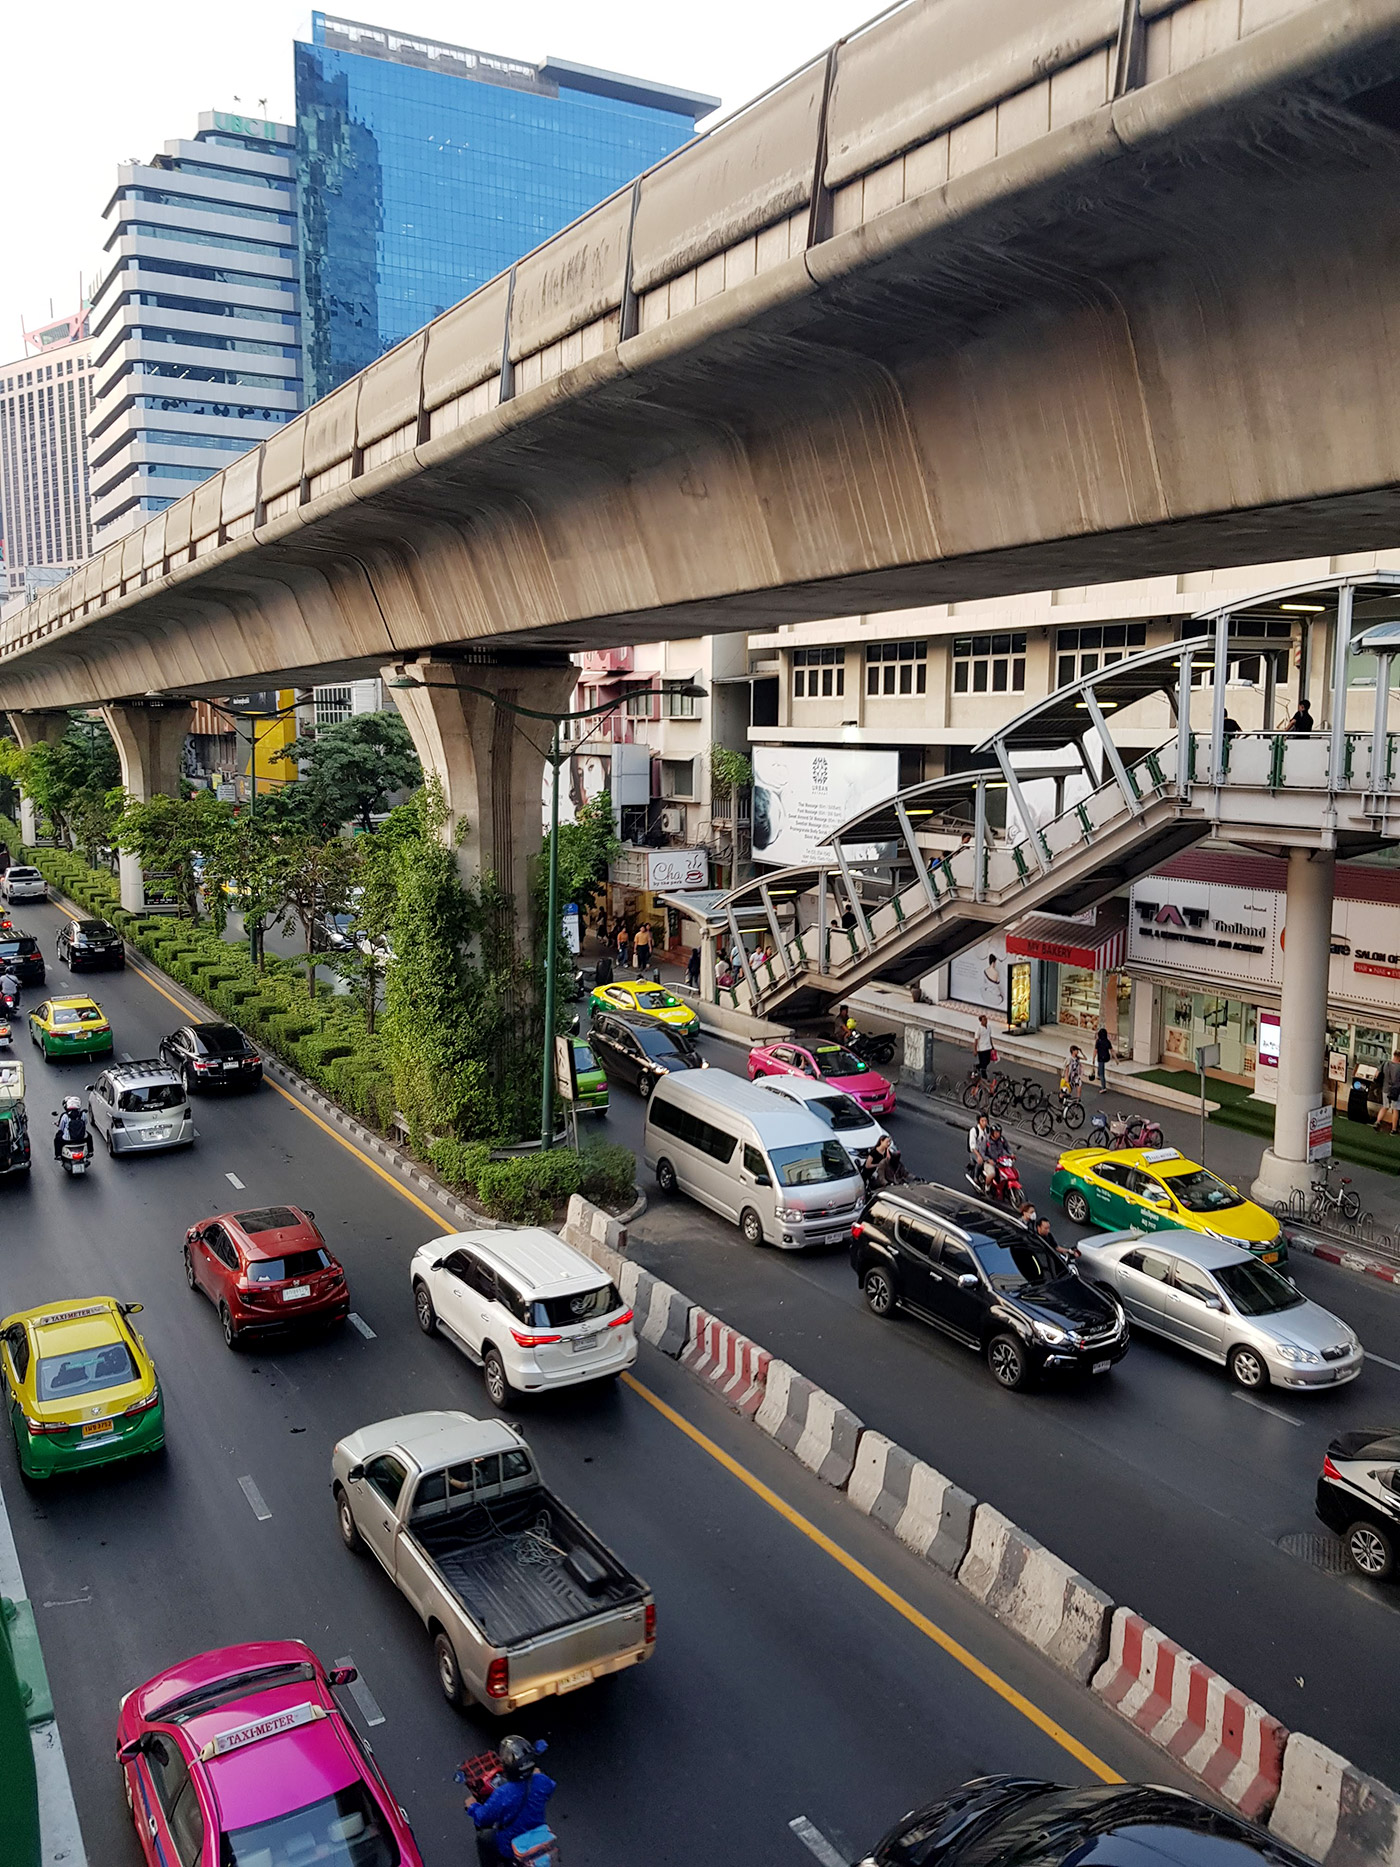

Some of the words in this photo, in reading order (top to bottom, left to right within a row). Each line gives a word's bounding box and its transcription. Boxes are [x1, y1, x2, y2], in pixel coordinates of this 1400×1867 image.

[214, 111, 259, 137] UBC
[653, 862, 683, 881] Cha
[1211, 918, 1266, 938] Thailand
[1027, 940, 1039, 951] MY
[1042, 944, 1073, 958] BAKERY
[1354, 949, 1386, 962] SALON
[1355, 964, 1367, 972] HAIR
[226, 1714, 295, 1746] TAXI-METER
